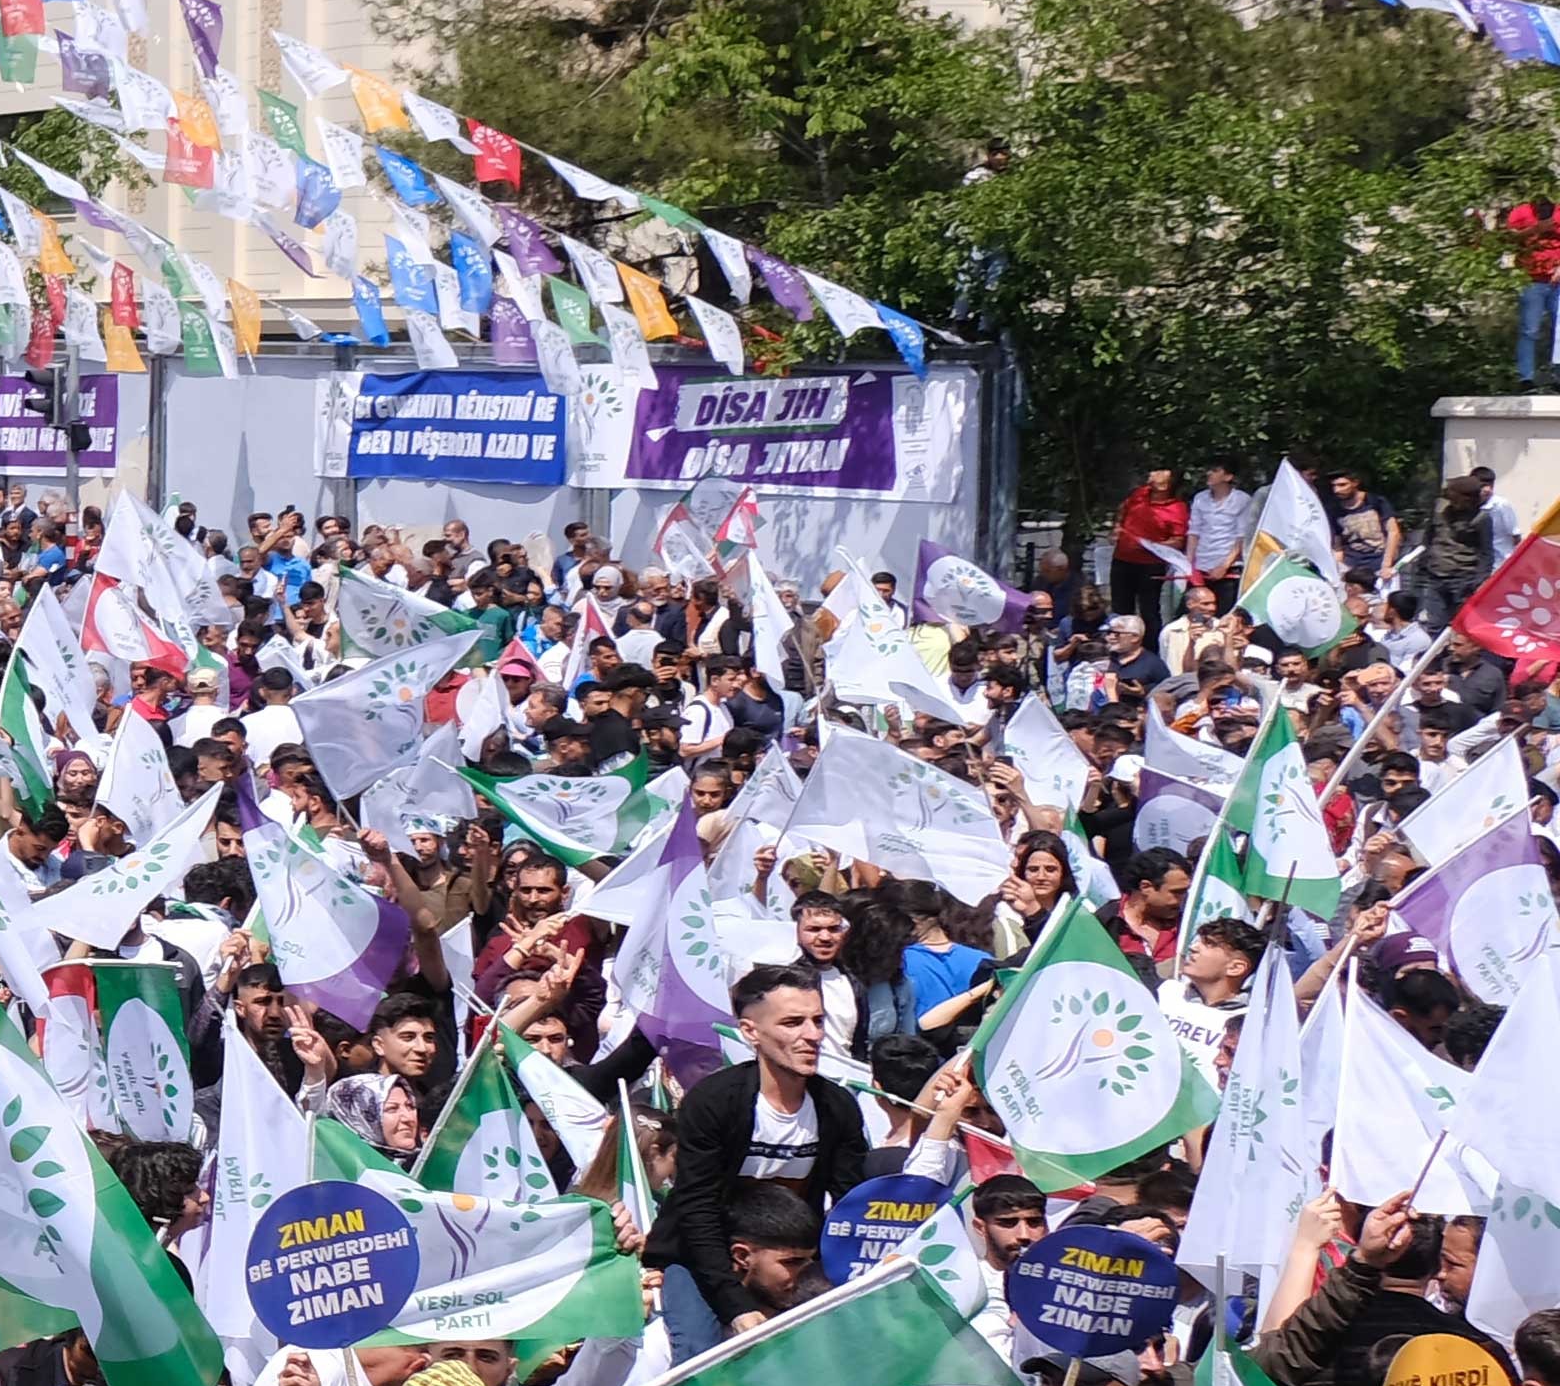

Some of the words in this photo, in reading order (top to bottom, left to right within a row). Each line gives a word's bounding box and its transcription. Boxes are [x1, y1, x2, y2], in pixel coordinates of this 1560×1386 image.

[695, 386, 768, 426] DÎSA
[863, 1200, 937, 1223] ZIMAN
[278, 1209, 366, 1249] ZIMAN
[827, 1220, 852, 1237] BÊ
[249, 1261, 273, 1284] BÊ
[274, 1226, 412, 1274] PERWERDEHÎ
[1060, 1246, 1146, 1279] ZIMAN
[290, 1256, 372, 1296] NABE
[1018, 1261, 1046, 1277] BÊ
[1048, 1263, 1177, 1299] PERWERDEHÎ
[286, 1282, 384, 1326] ZIMAN
[415, 1291, 467, 1312] YEŞİL
[472, 1290, 510, 1306] SOL
[1052, 1283, 1132, 1315] NABE
[435, 1311, 490, 1331] PARTİ
[1039, 1303, 1134, 1336] ZIMAN
